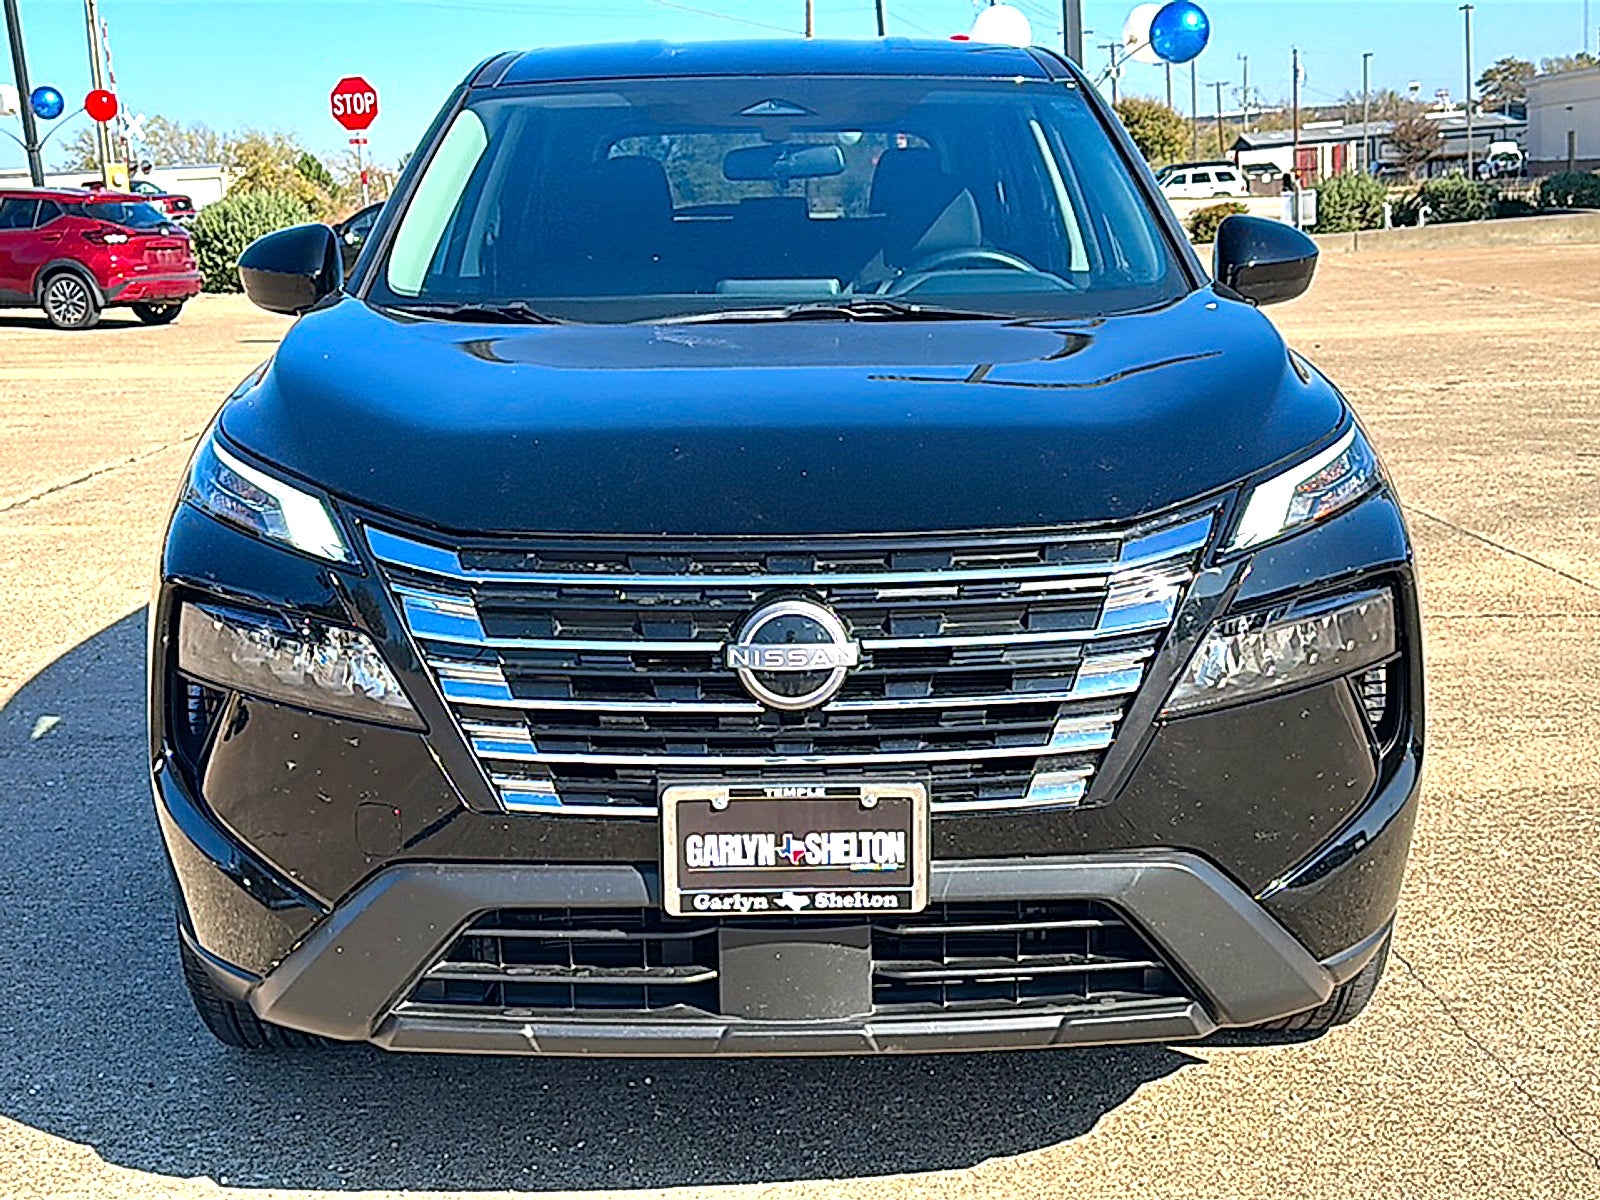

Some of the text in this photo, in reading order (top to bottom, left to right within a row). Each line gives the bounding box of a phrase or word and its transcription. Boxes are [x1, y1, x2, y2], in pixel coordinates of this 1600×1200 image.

[333, 92, 375, 116] STOP
[729, 648, 858, 667] NISSAN
[763, 787, 826, 798] TEMPLE
[686, 831, 906, 867] GARLYN SHELTON
[693, 891, 899, 912] Garlyn Shelton
